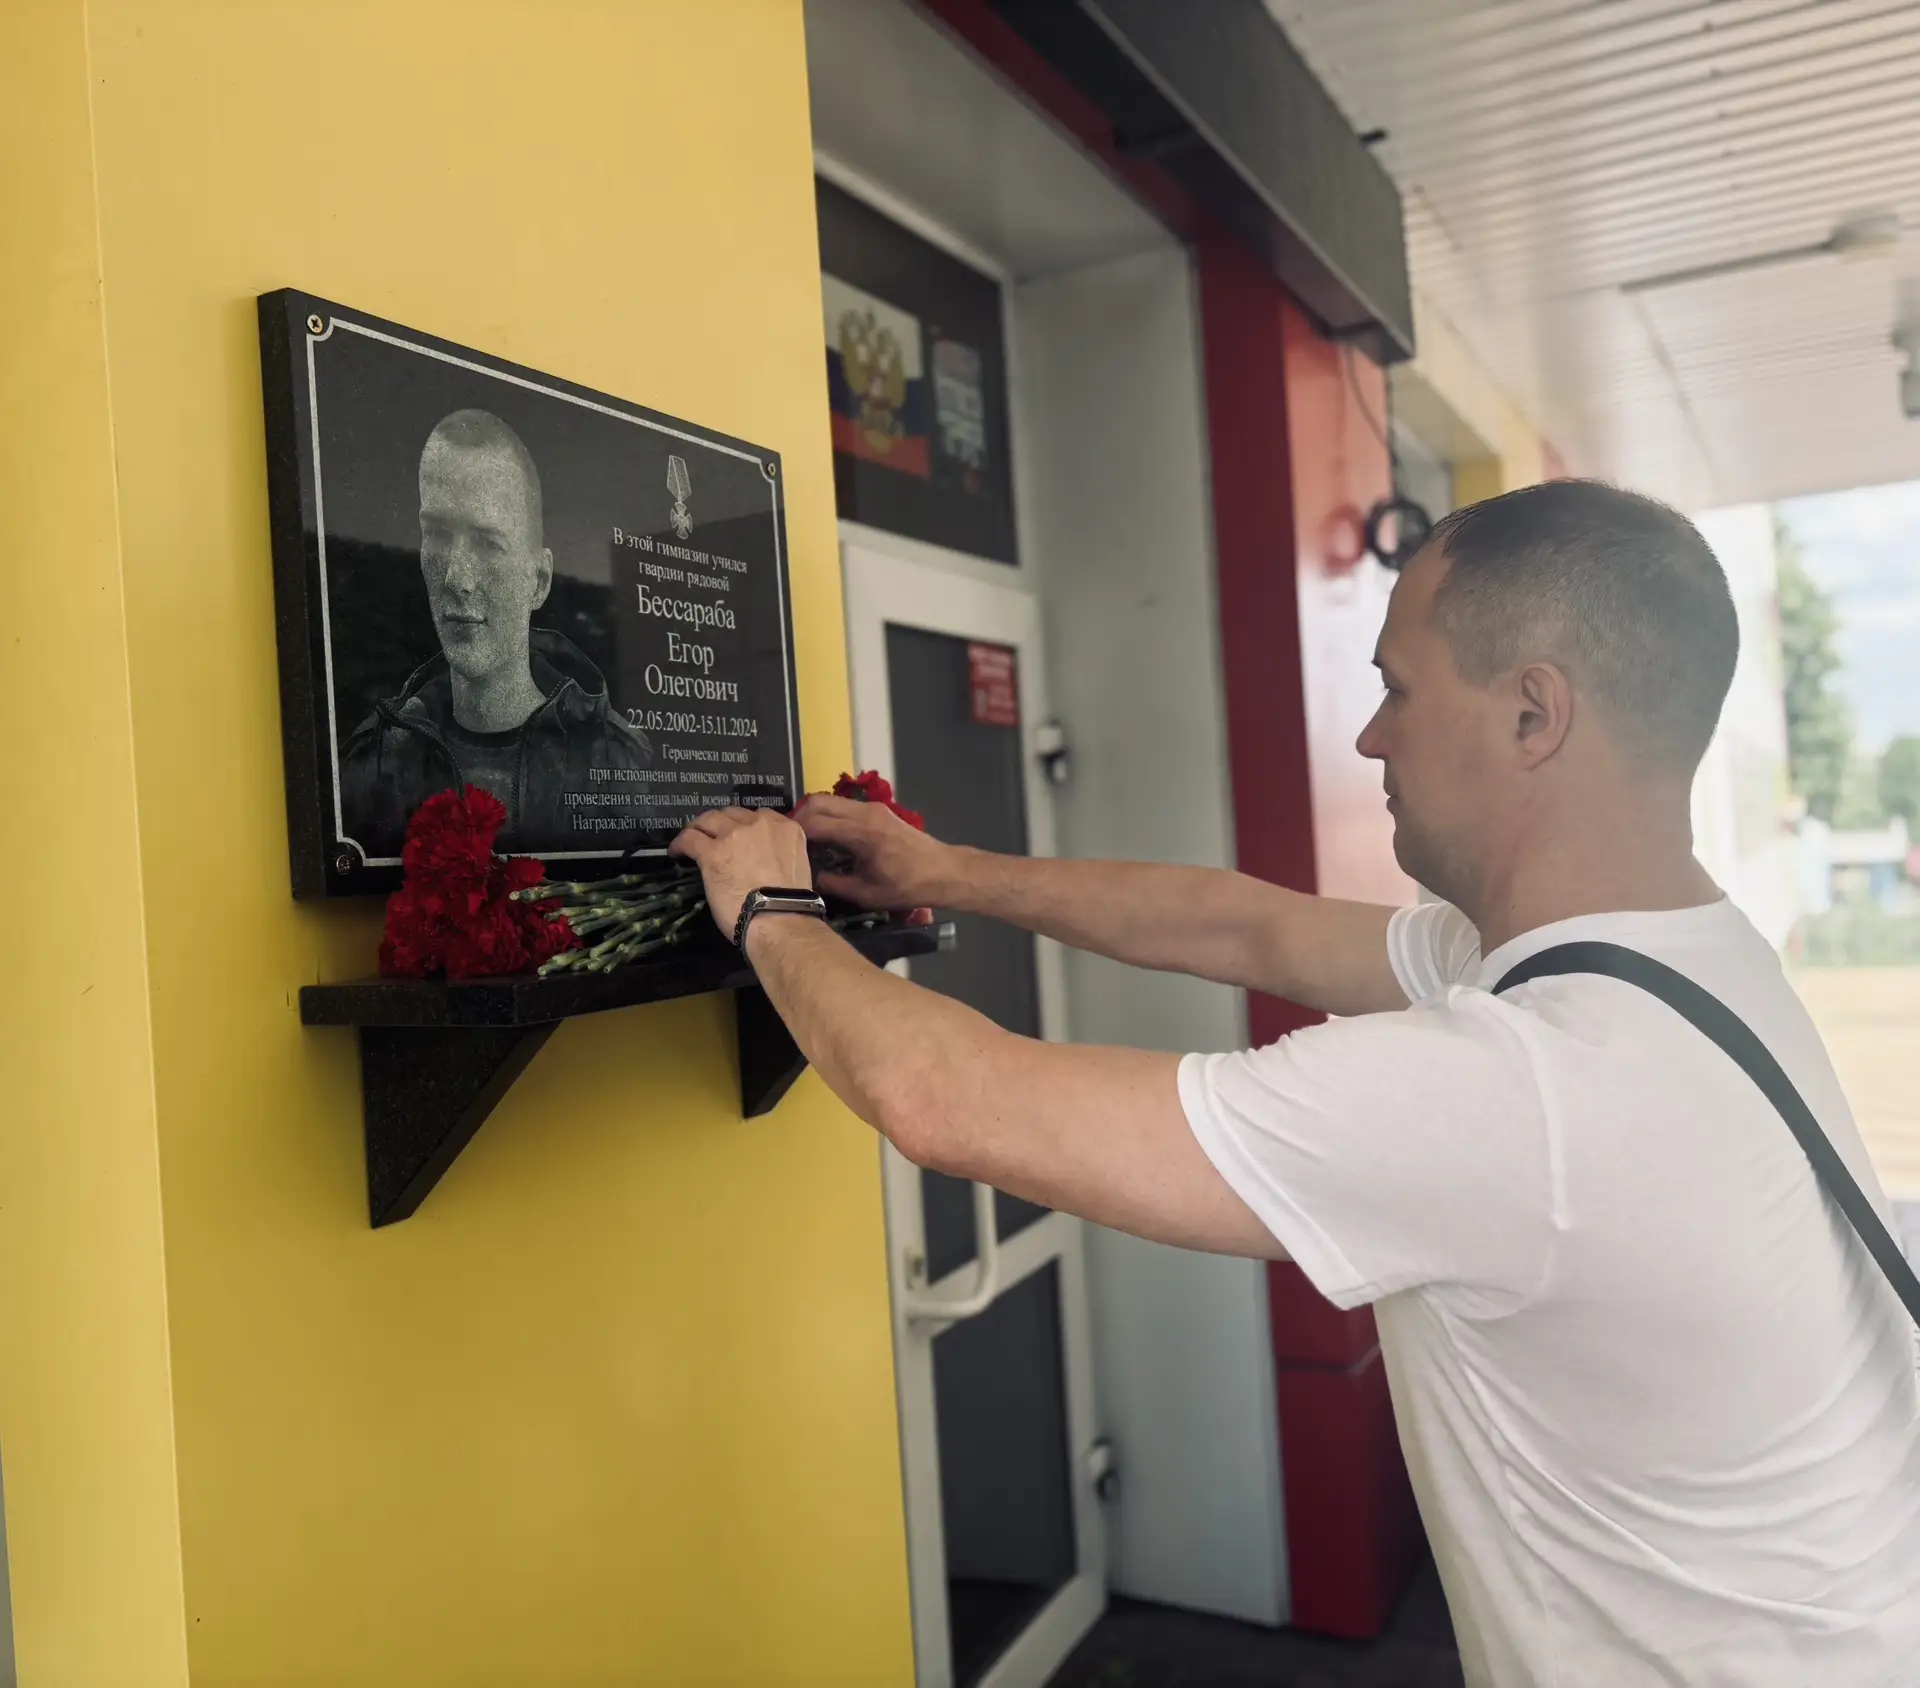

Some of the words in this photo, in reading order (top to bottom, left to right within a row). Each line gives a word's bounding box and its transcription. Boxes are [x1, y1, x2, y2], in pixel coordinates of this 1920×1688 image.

[613, 527, 624, 544] В
[627, 535, 653, 553] этой
[657, 542, 709, 565] гимназии
[711, 554, 748, 574] учился
[638, 561, 684, 582] гвардии
[687, 571, 730, 591] рядовой
[636, 583, 736, 631] Бессараба
[666, 631, 715, 674] Егор
[645, 664, 739, 702] Олегович
[627, 708, 758, 737] 22.05.2002-15.11.2024
[662, 744, 719, 763] Героически
[722, 748, 749, 764] погиб
[589, 768, 611, 784] при
[614, 768, 677, 783] исполнении
[680, 771, 729, 784] воинского
[758, 774, 764, 785] в
[564, 792, 631, 809] проведения
[634, 792, 699, 807] специальной
[702, 792, 740, 806] военнй
[572, 813, 636, 834] Награждён
[640, 816, 683, 833] орденом
